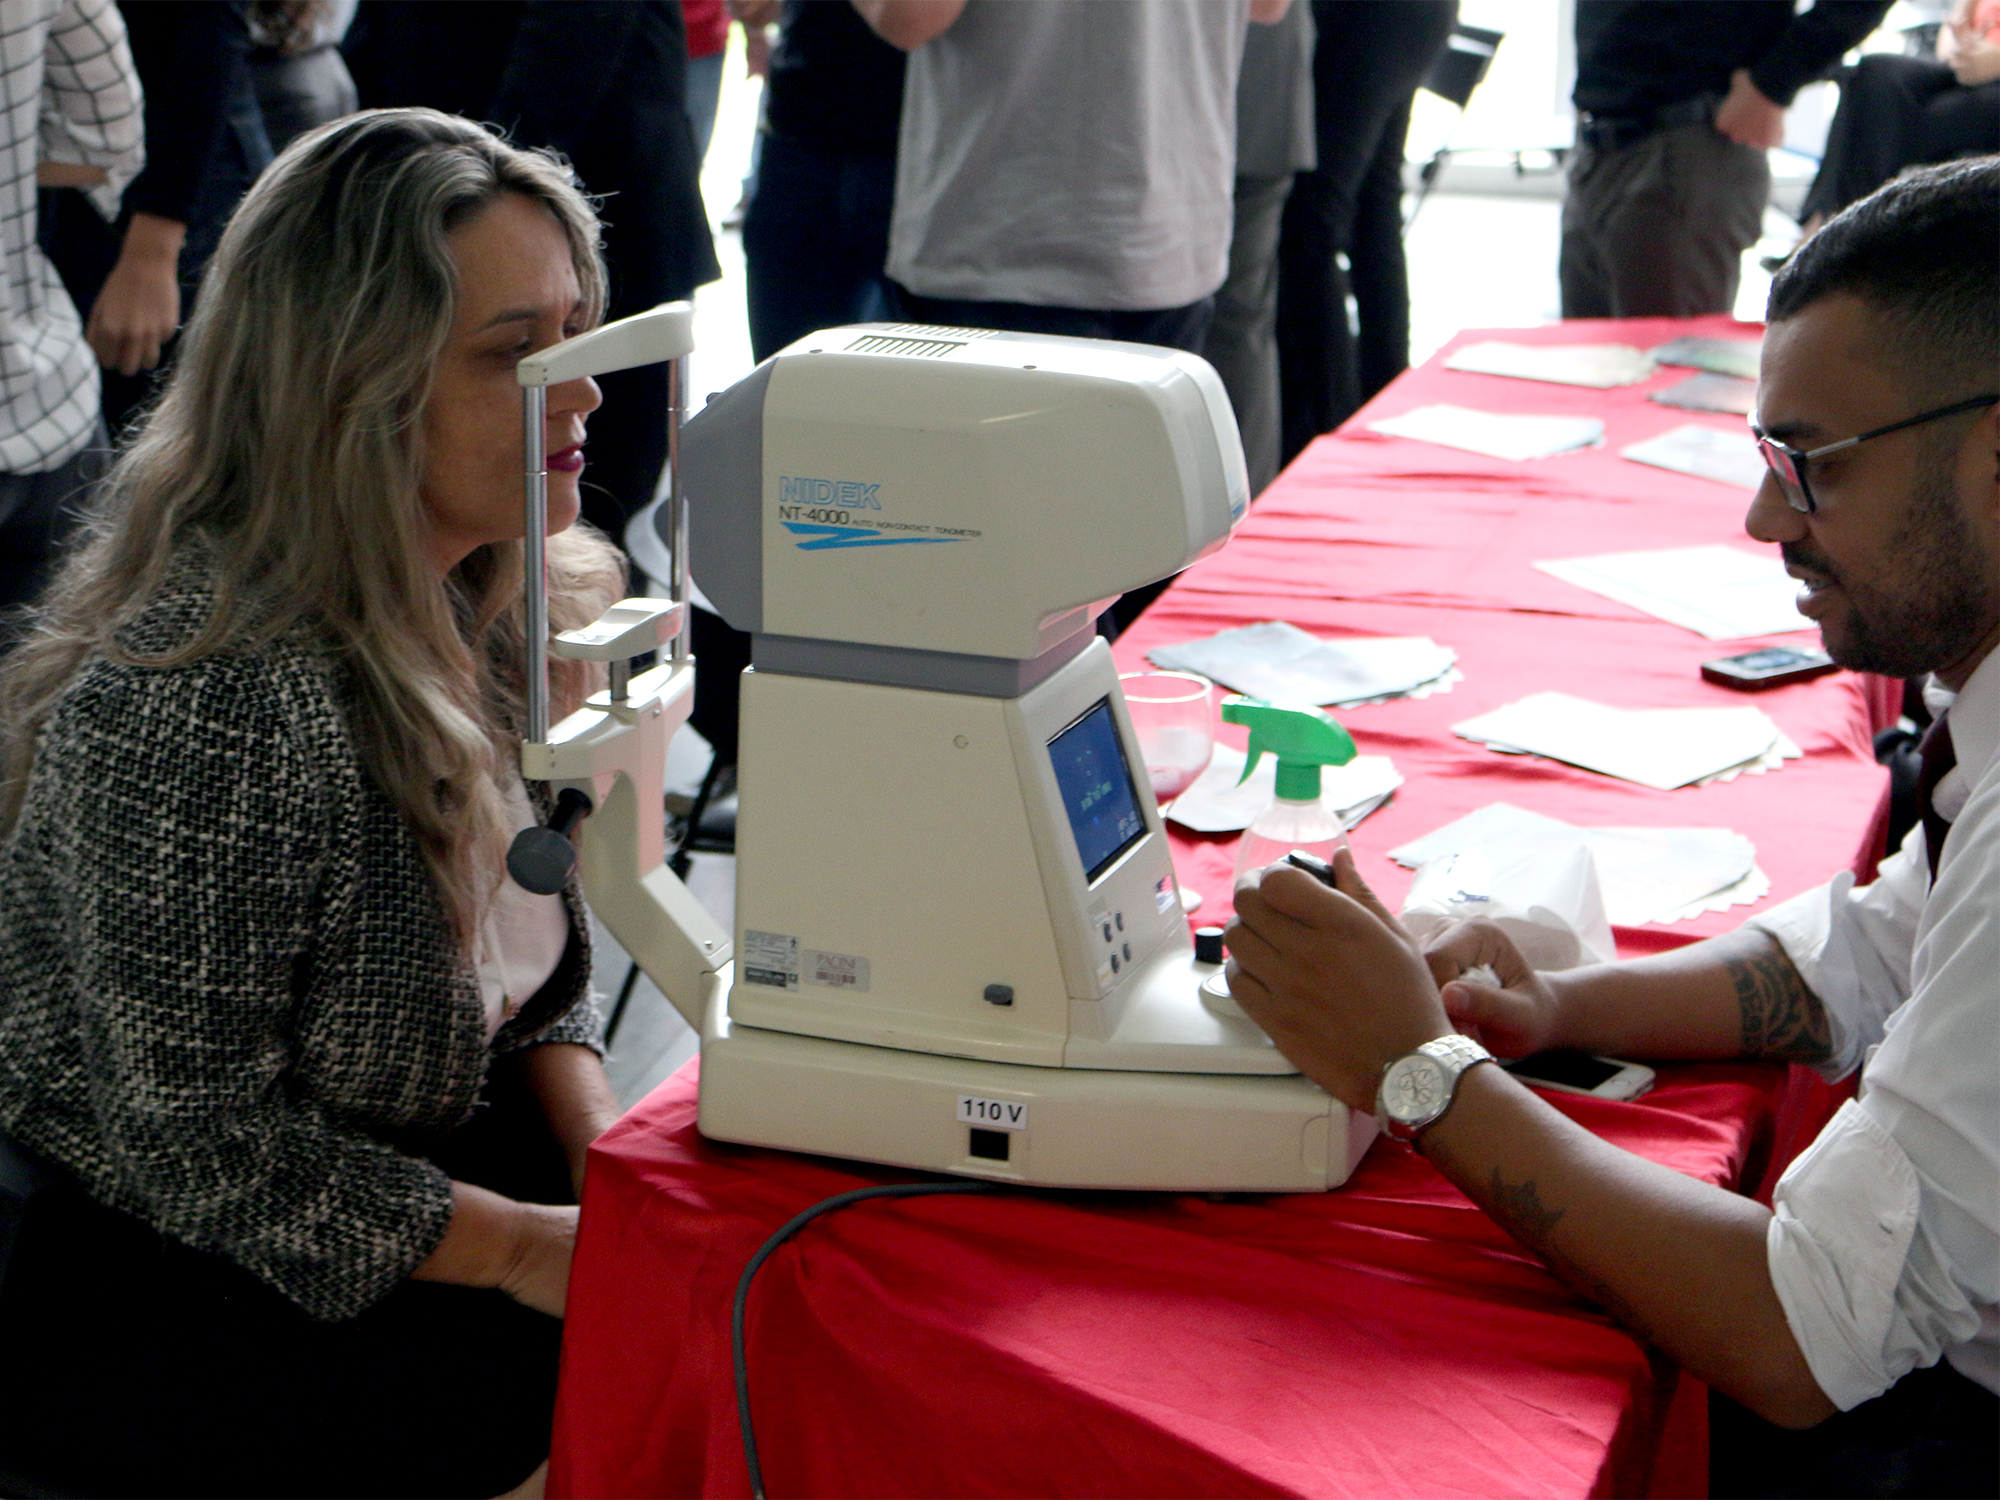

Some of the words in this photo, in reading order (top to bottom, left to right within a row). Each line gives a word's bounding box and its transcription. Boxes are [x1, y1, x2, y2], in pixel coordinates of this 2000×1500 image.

[780, 476, 882, 510] NIDEK
[779, 505, 849, 525] NT-4000
[964, 1099, 1001, 1120] 110
[1008, 1104, 1022, 1123] V
